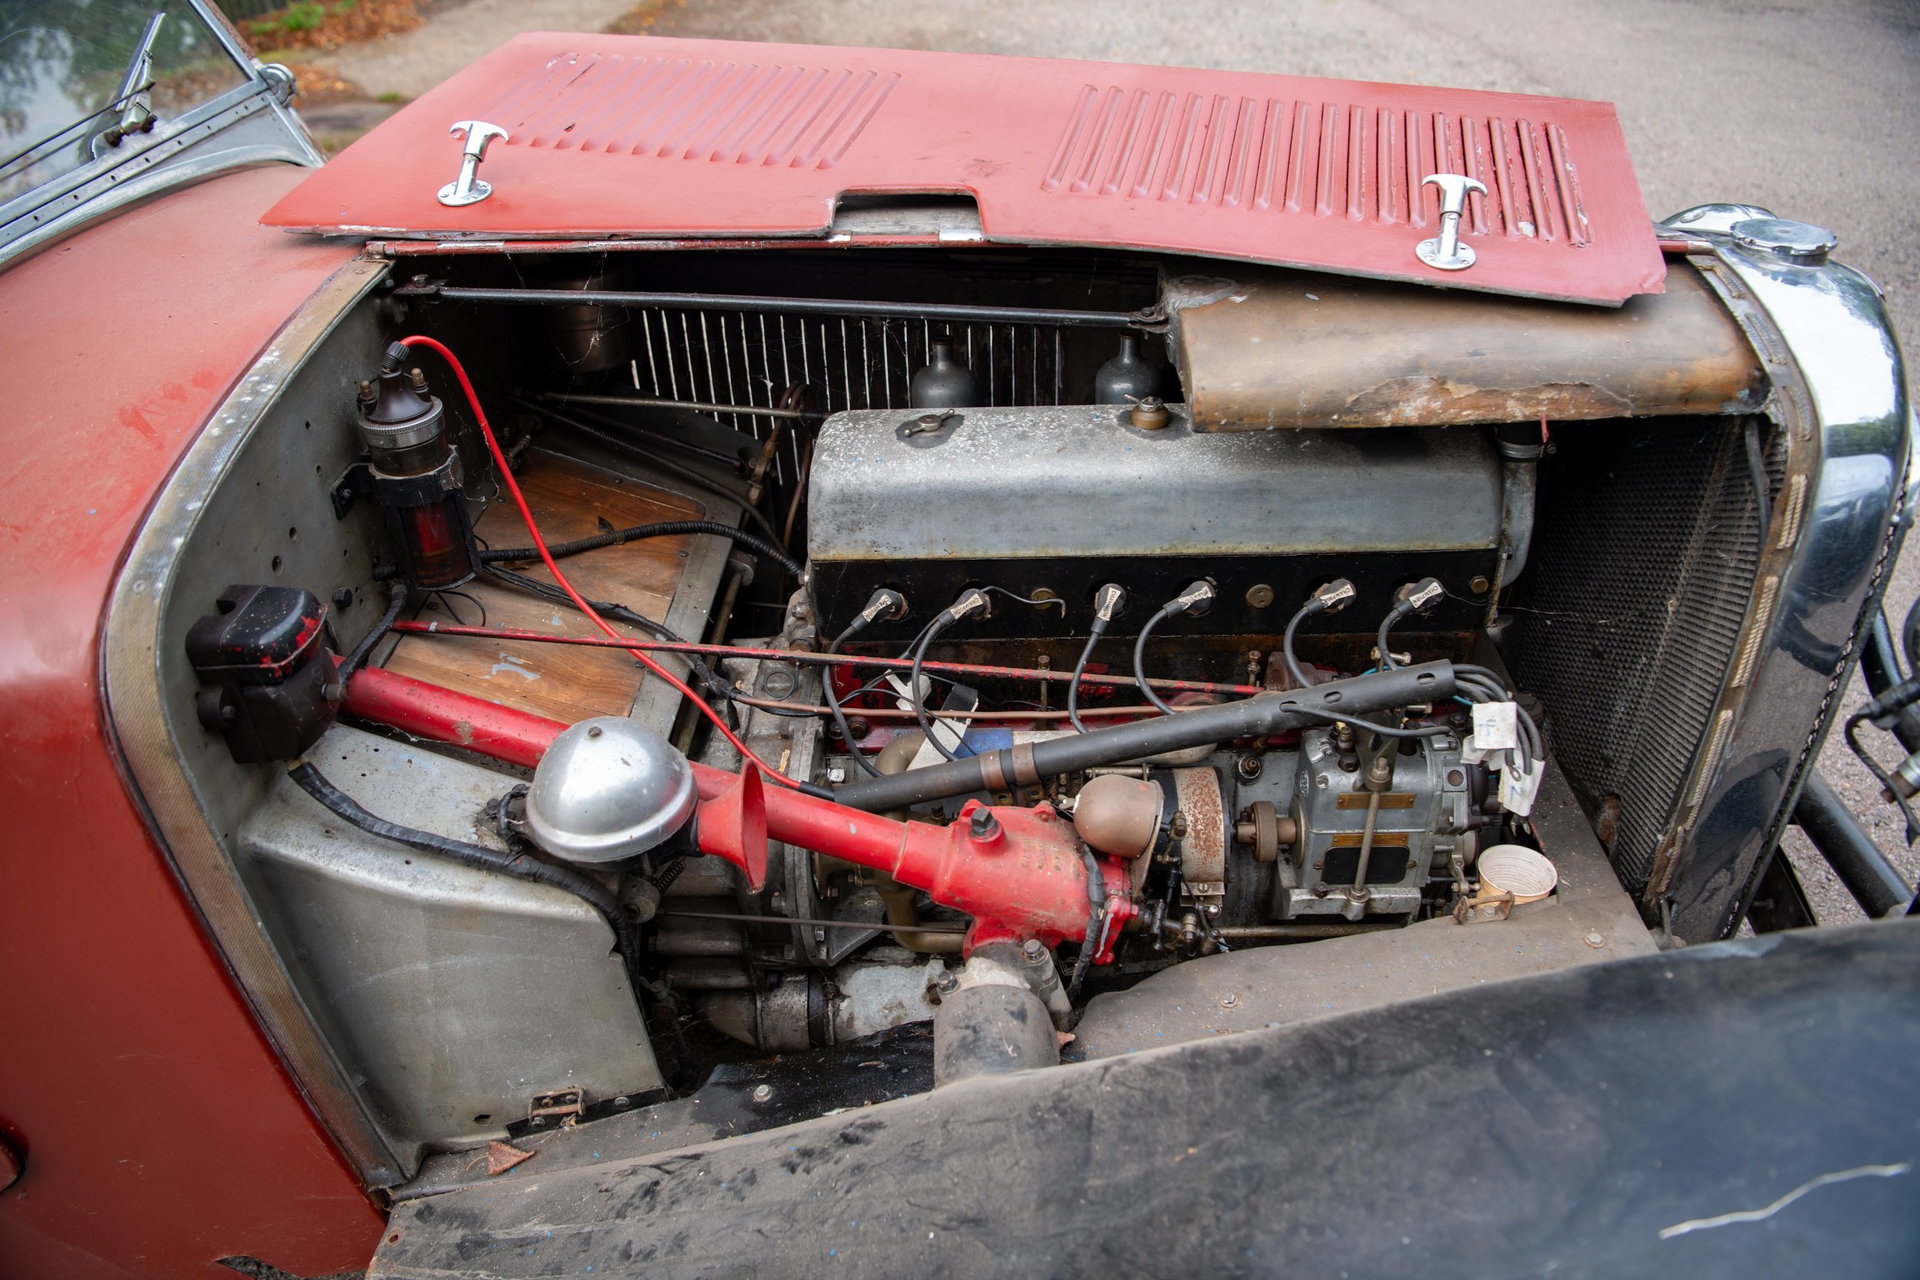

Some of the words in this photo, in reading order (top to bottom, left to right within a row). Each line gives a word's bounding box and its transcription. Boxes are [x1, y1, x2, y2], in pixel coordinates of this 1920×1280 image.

[1102, 590, 1117, 618] CHAMPION
[1412, 585, 1438, 604] CHAMPION
[953, 595, 979, 616] CHAMPION
